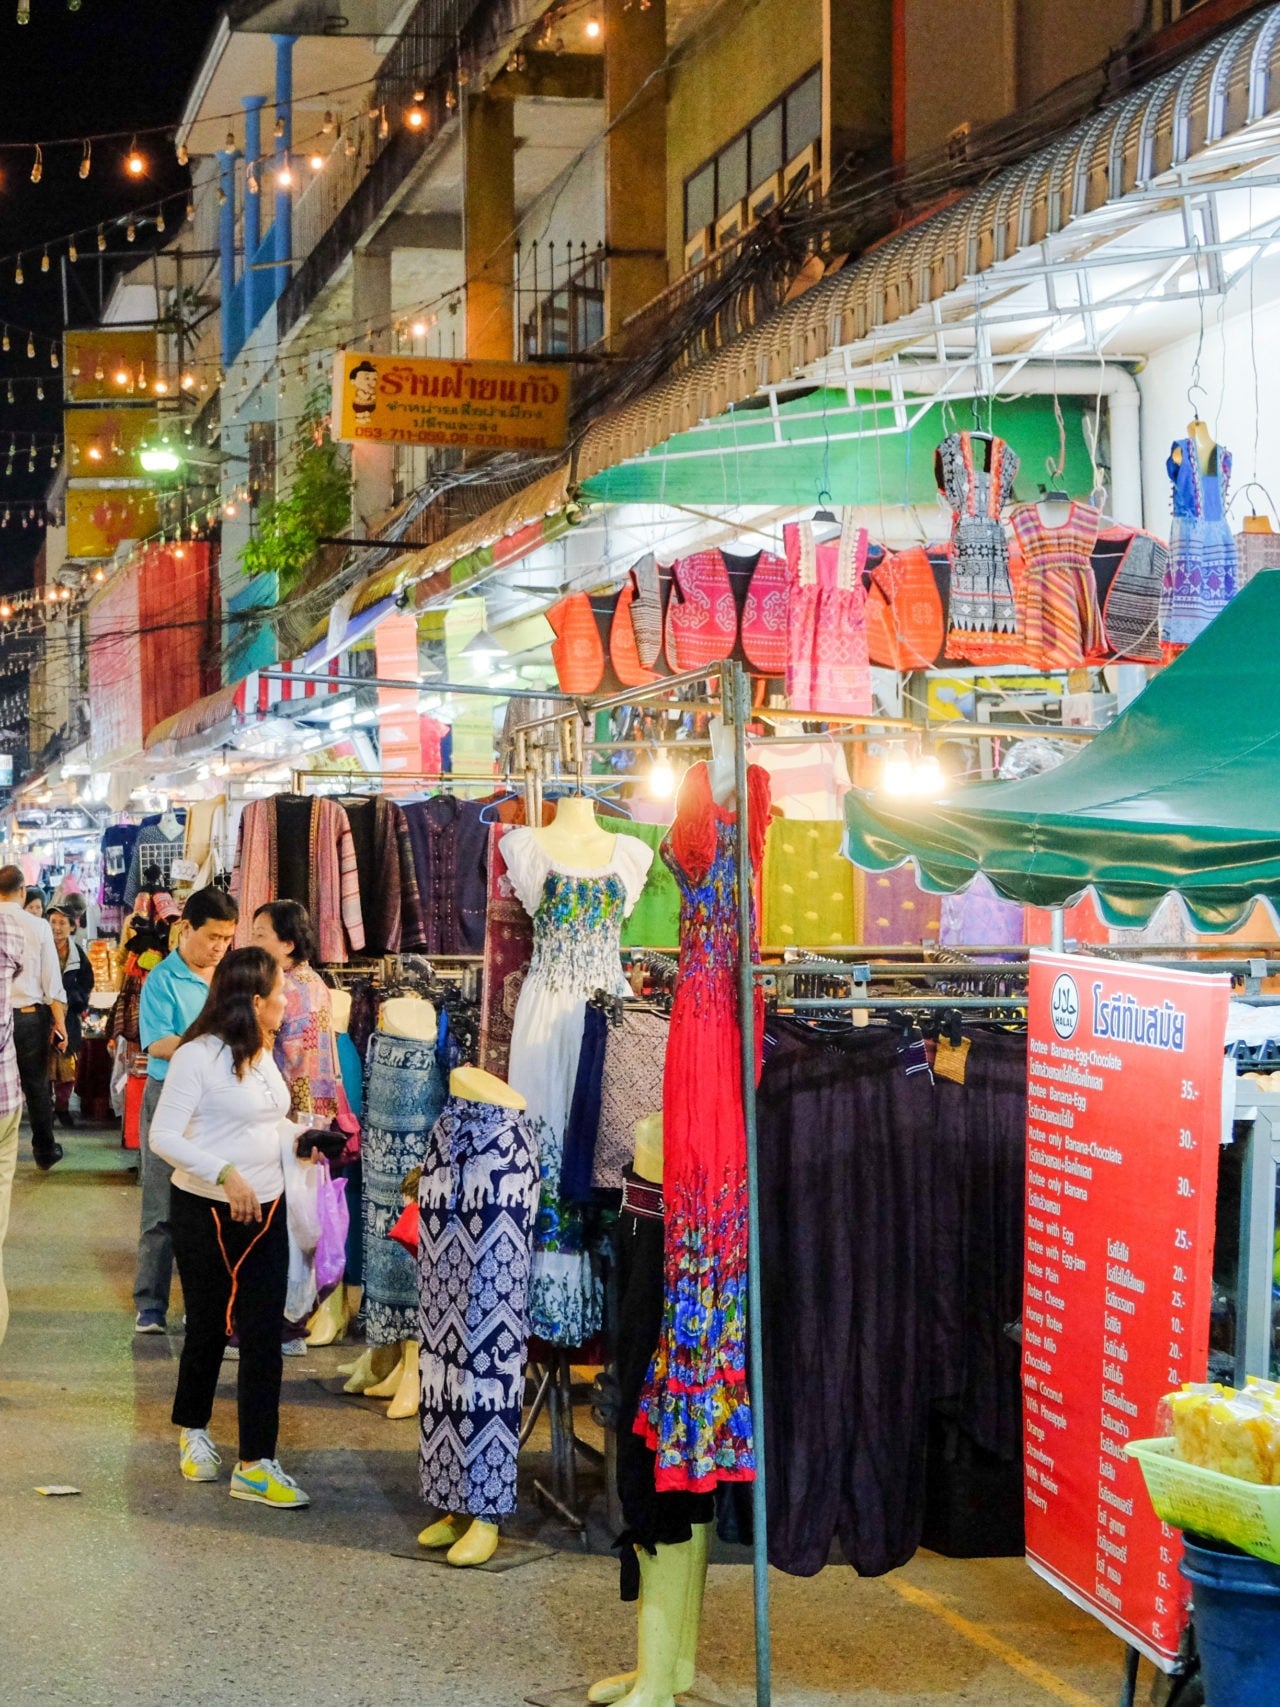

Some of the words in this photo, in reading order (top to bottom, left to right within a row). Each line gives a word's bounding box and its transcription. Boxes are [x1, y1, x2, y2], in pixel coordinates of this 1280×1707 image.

[1055, 1016, 1073, 1028] HALAL
[1093, 983, 1185, 1051] โรตีทันสมัย
[1030, 1039, 1048, 1055] Rotee
[1051, 1043, 1122, 1070] Banana-Egg-Chocolate
[1029, 1082, 1047, 1099] Rotee
[1049, 1087, 1086, 1109] Banana-Egg
[1028, 1126, 1046, 1143] Rotee
[1048, 1132, 1062, 1150] only
[1065, 1135, 1122, 1164] Banana-Chocolate
[1028, 1170, 1045, 1187] Rotee
[1047, 1176, 1062, 1196] only
[1064, 1180, 1088, 1200] Banana
[1028, 1215, 1044, 1232] Rotee
[1046, 1223, 1059, 1238] with
[1062, 1227, 1074, 1247] Egg
[1027, 1237, 1043, 1255] Rotee
[1045, 1245, 1059, 1261] with
[1027, 1260, 1043, 1278] Rotee
[1045, 1266, 1059, 1284] Plain
[1027, 1283, 1043, 1300] Rotee
[1045, 1290, 1065, 1311] Cheese
[1026, 1306, 1044, 1328] Honey
[1046, 1314, 1063, 1333] Rotee
[1025, 1329, 1041, 1346] Rotee
[1044, 1337, 1057, 1354] Milo
[1025, 1351, 1052, 1375] Chocolate
[1024, 1374, 1038, 1392] With
[1040, 1381, 1063, 1404] Coconut
[1025, 1396, 1039, 1414] With
[1041, 1404, 1067, 1430] Pineapple
[1026, 1419, 1045, 1442] Orange
[1025, 1463, 1039, 1484] With
[1040, 1471, 1059, 1495] Raisins
